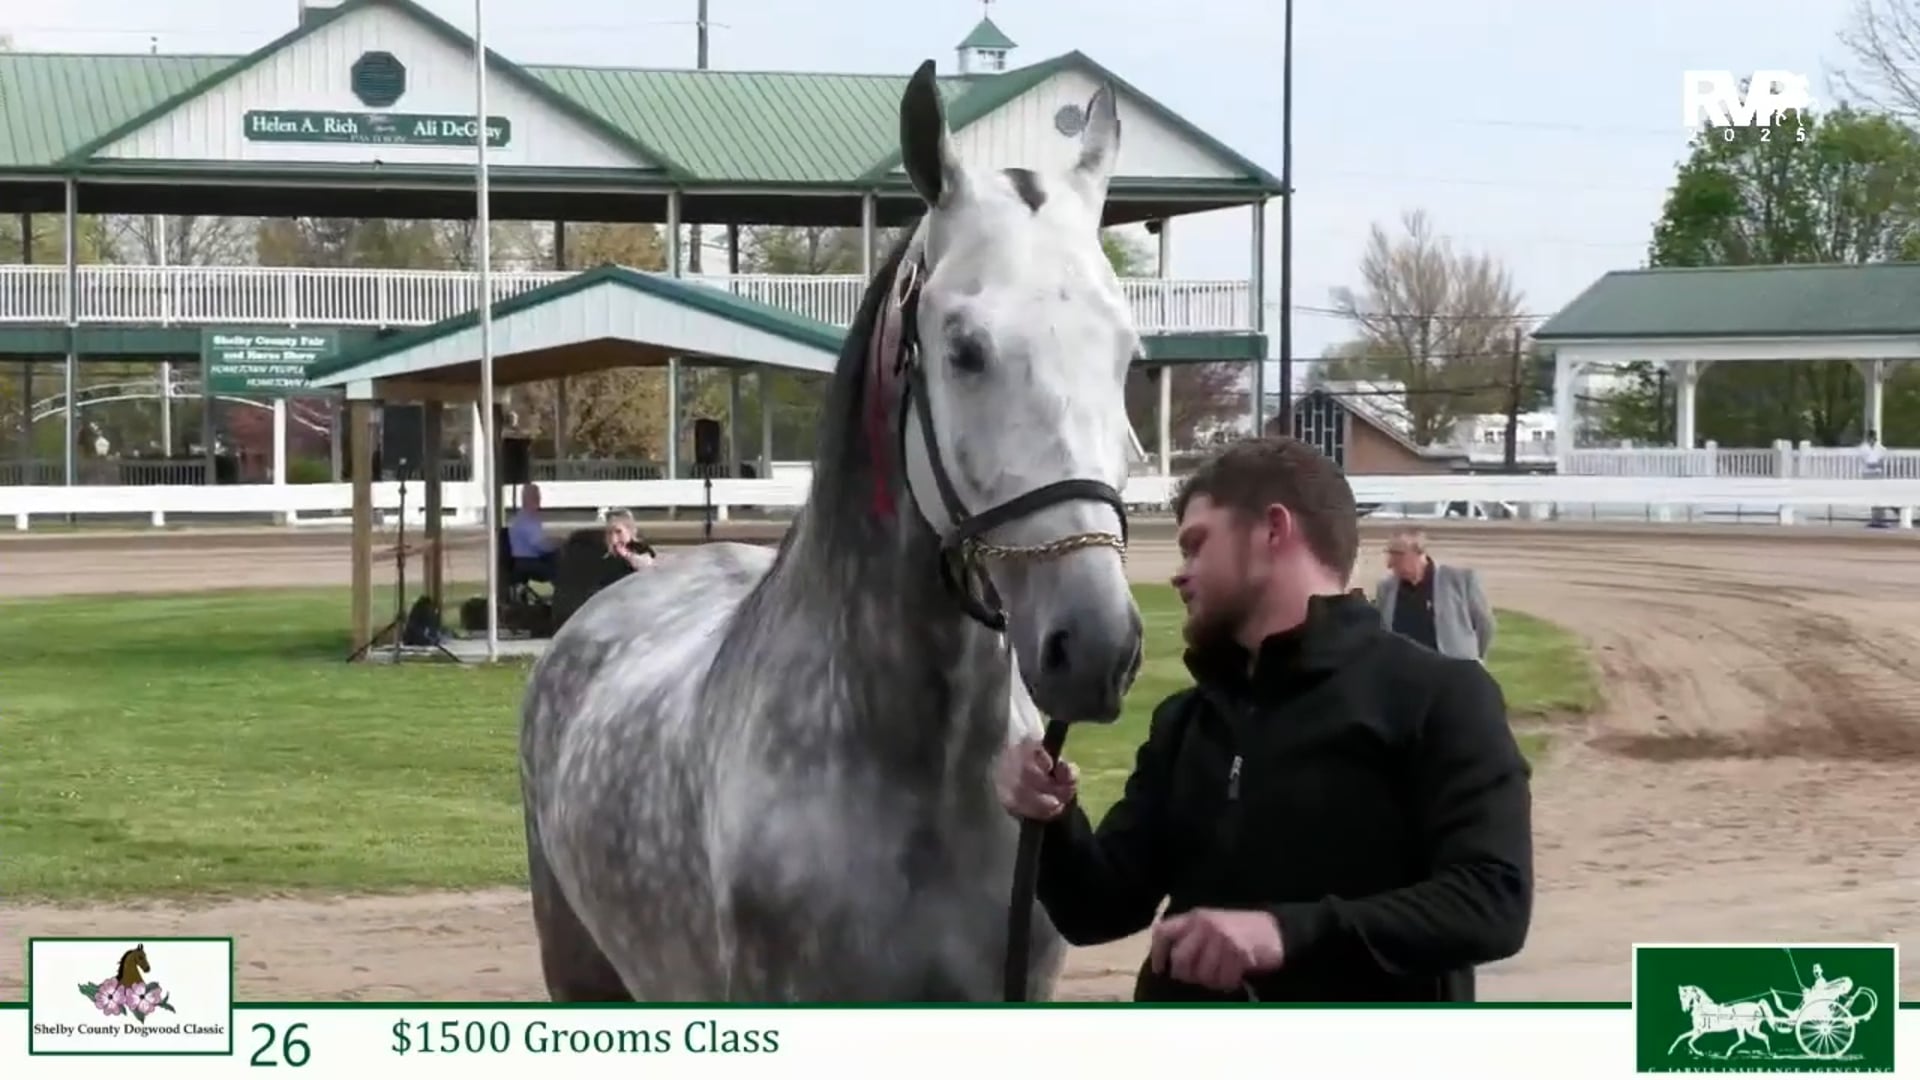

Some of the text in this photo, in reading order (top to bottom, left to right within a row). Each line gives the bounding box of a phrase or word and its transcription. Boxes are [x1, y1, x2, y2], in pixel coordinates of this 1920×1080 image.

[252, 116, 297, 133] Helen
[301, 118, 318, 133] A.
[324, 118, 358, 134] Rich
[413, 120, 437, 136] Ali
[442, 121, 502, 140] DeGay
[213, 335, 325, 347] Shelby County Fair
